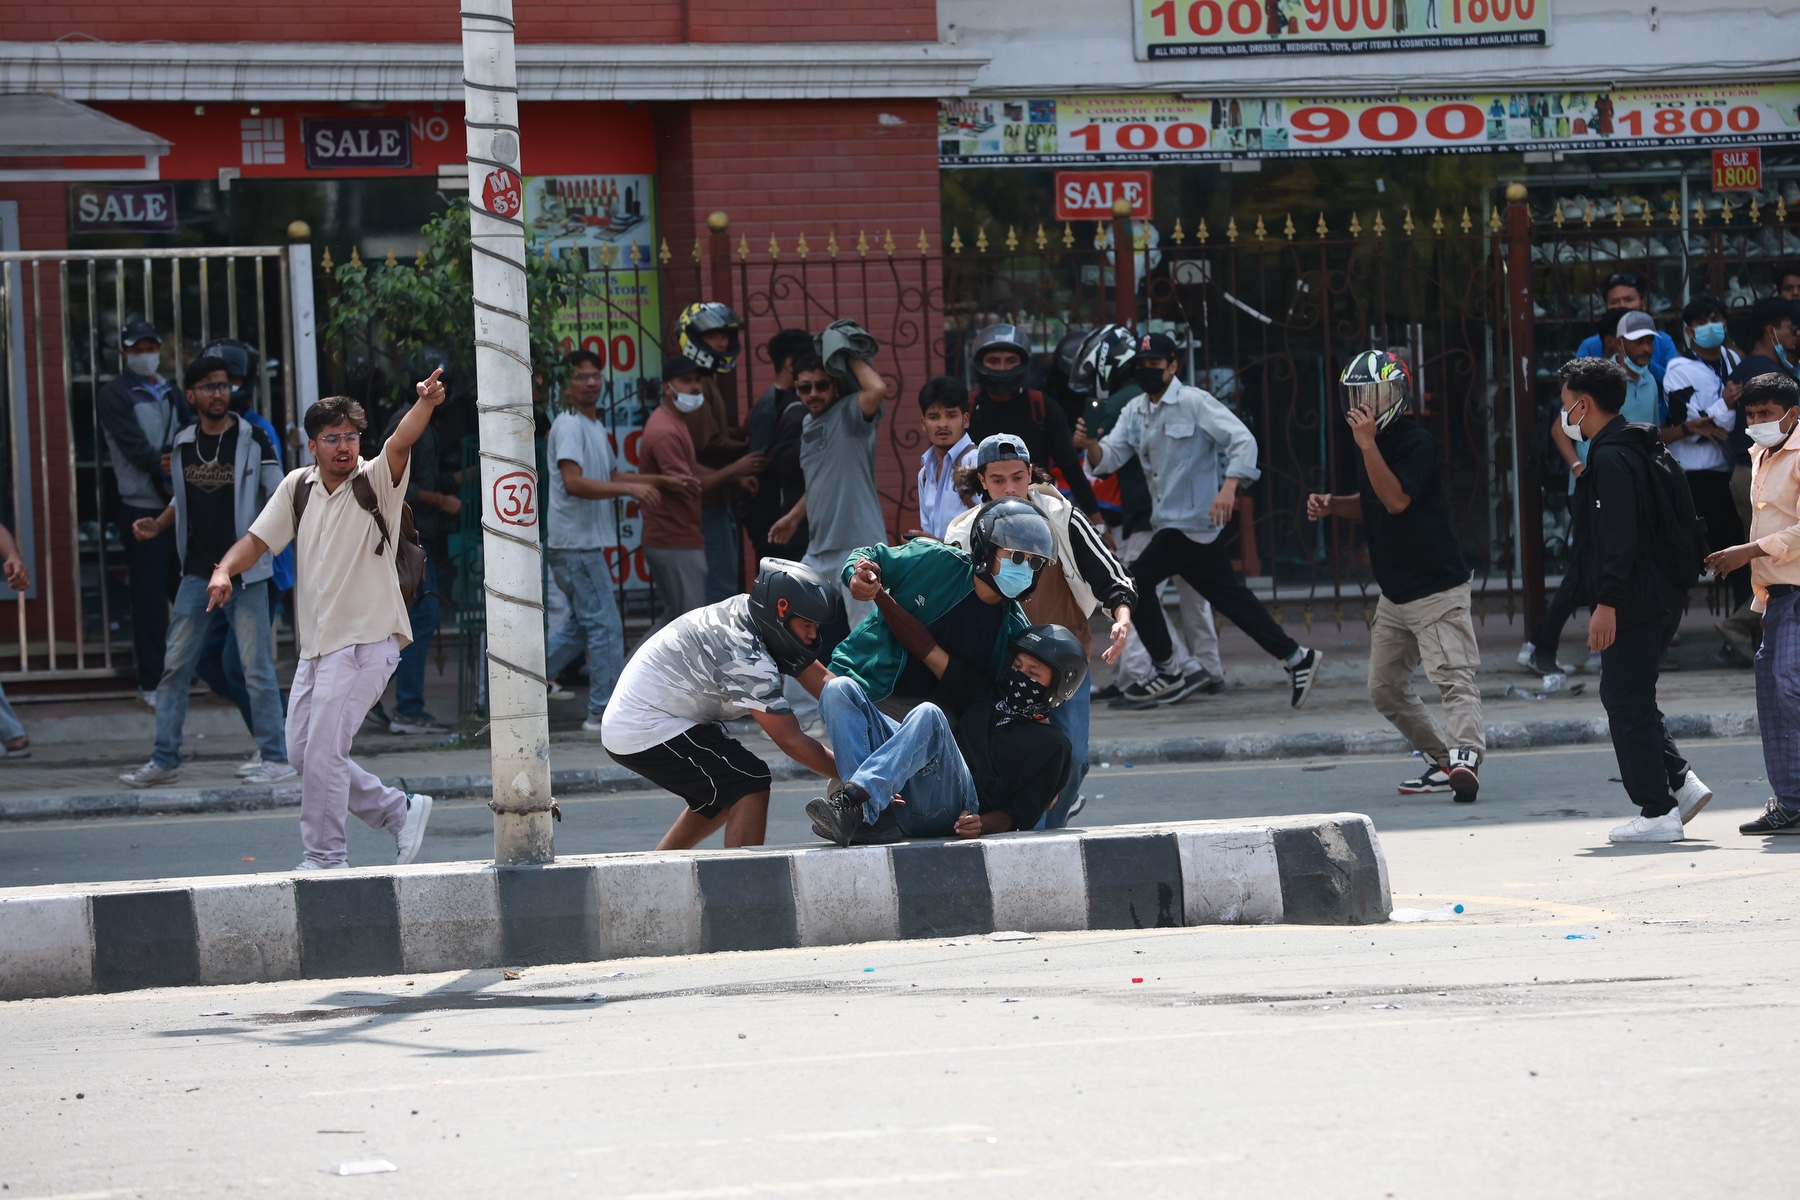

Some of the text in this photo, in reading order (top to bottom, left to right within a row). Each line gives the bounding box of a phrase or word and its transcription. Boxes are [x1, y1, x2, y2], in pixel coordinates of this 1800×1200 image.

[1151, 0, 1262, 36] 100
[1304, 0, 1387, 33] 900
[1352, 41, 1368, 51] GIFT
[1370, 40, 1391, 50] ITEMS
[1392, 40, 1399, 48] &
[1400, 38, 1440, 48] COSMETICS
[1442, 37, 1463, 47] ITEMS
[1464, 36, 1479, 46] ARE
[1480, 33, 1519, 45] AVAILABLE
[1650, 101, 1685, 109] TO
[1088, 115, 1181, 124] FROM RS
[1290, 103, 1485, 144] 900
[1617, 105, 1760, 137] 1800
[315, 129, 401, 158] SALE
[1069, 122, 1208, 151] 100
[1722, 152, 1749, 168] SALE
[489, 171, 512, 194] M
[1715, 167, 1758, 188] 1800
[79, 194, 168, 222] SALE
[1064, 181, 1143, 209] SALE
[502, 483, 535, 517] 32
